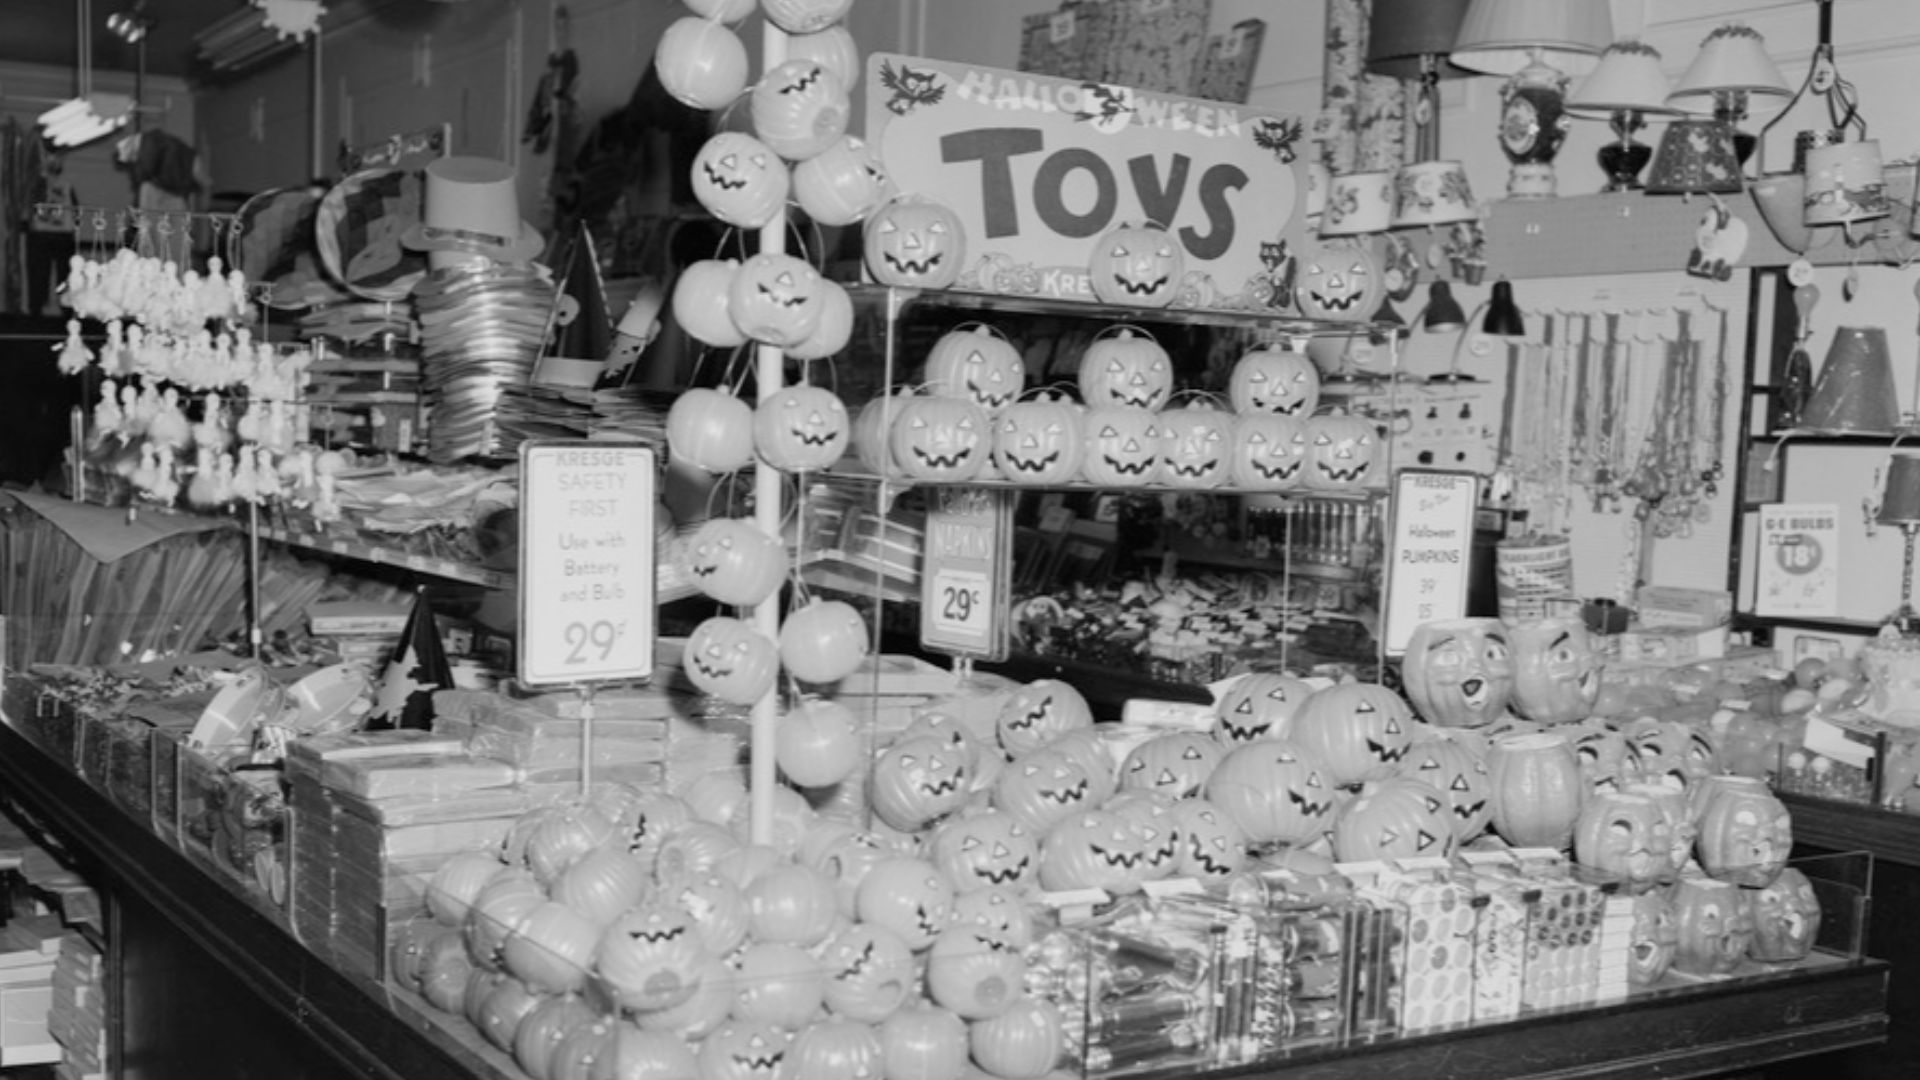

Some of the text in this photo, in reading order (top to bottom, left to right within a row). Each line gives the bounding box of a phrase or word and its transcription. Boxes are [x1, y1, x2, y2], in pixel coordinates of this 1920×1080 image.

[939, 127, 1250, 260] TOYS
[555, 451, 626, 467] KRESGE
[558, 472, 627, 491] SAFETY
[568, 499, 619, 517] FIRST
[558, 531, 626, 550] Use with
[1408, 524, 1456, 539] Halloween
[1402, 549, 1460, 564] PUMPKINS
[564, 558, 620, 577] Battery
[559, 583, 626, 602] and Bulb
